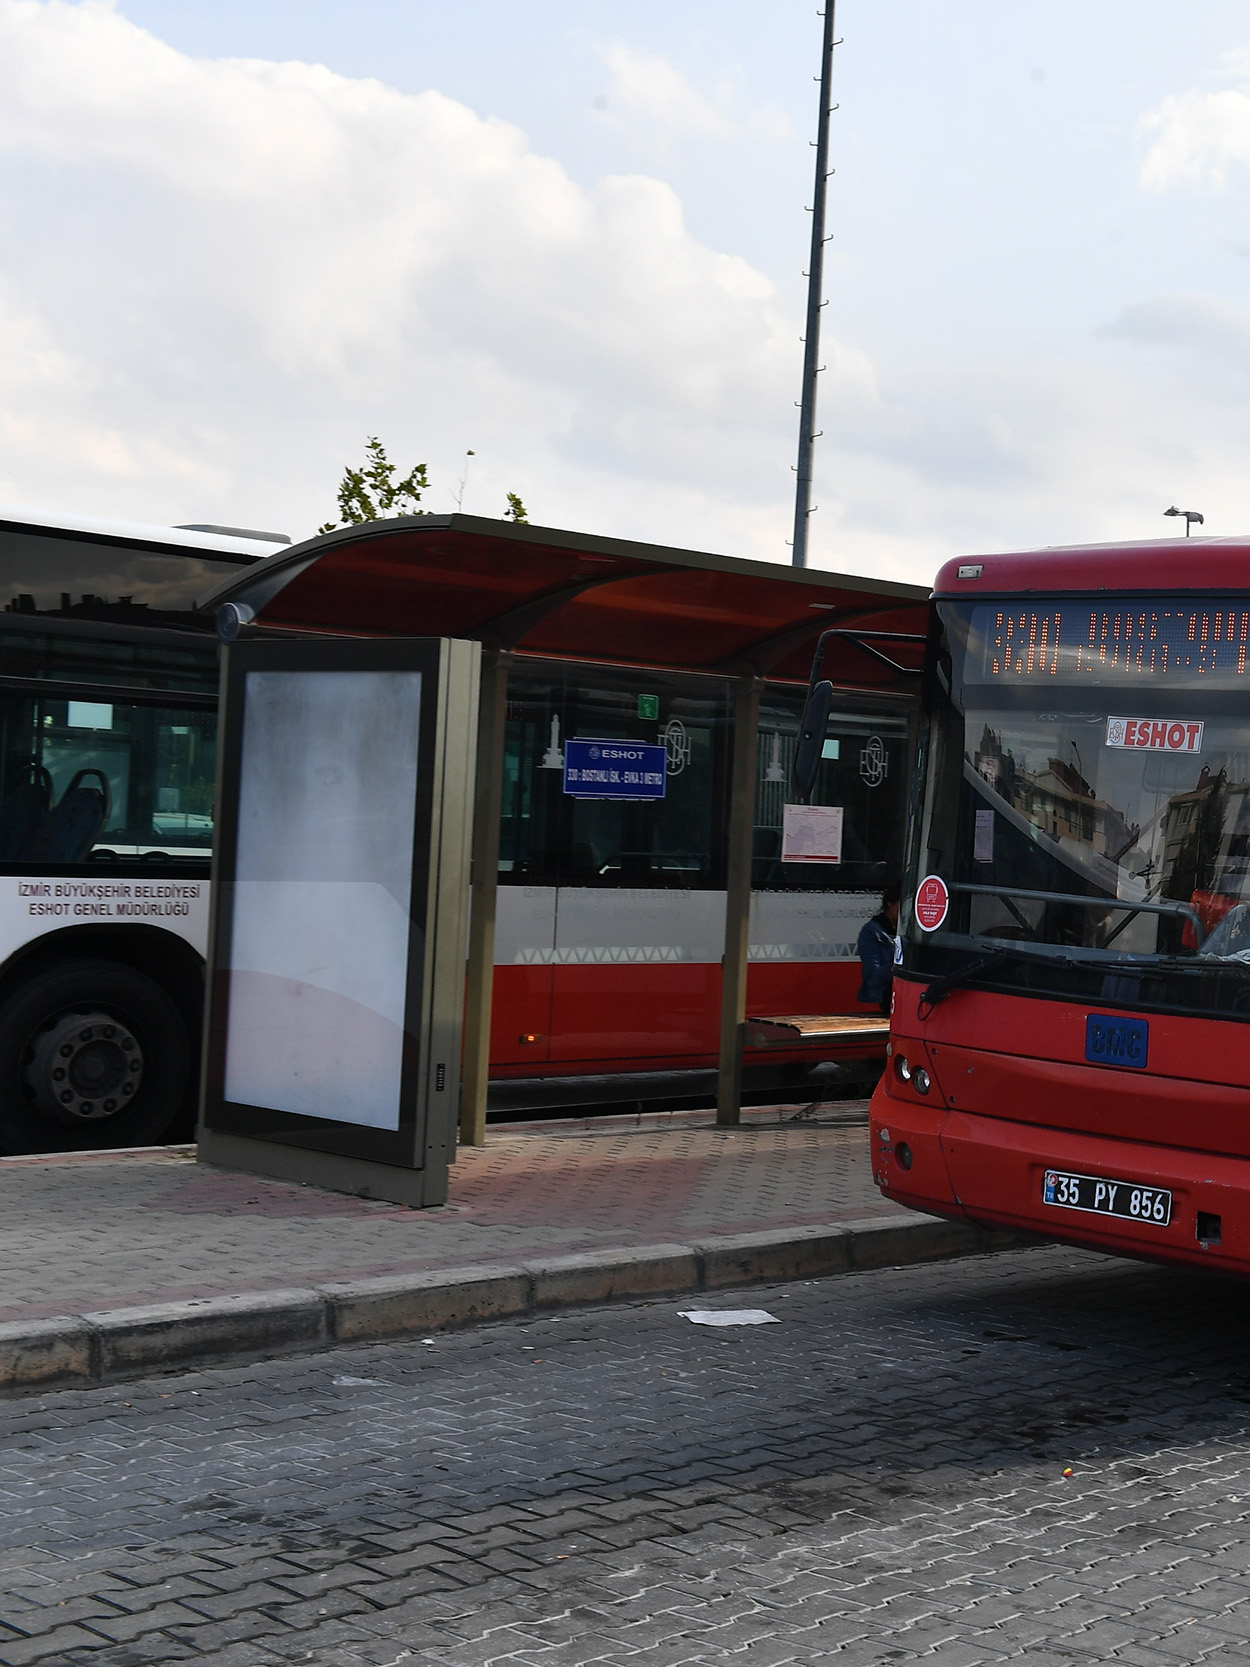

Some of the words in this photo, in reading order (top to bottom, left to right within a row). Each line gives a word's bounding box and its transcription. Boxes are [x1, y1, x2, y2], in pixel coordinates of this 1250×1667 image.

[1124, 721, 1200, 749] ESHOT
[602, 750, 645, 760] ESHOT
[18, 882, 52, 896] İZMİR
[55, 883, 131, 900] BÜYÜKŞEHİR
[135, 883, 200, 898] BELEDİYESİ
[29, 903, 70, 916] ESHOT
[73, 904, 112, 915] GENEL
[116, 902, 189, 916] MÜDÜRLÜĞÜ
[1093, 1025, 1141, 1058] BMC
[1057, 1176, 1080, 1204] 35
[1094, 1182, 1118, 1211] PY
[1130, 1189, 1165, 1220] 856
